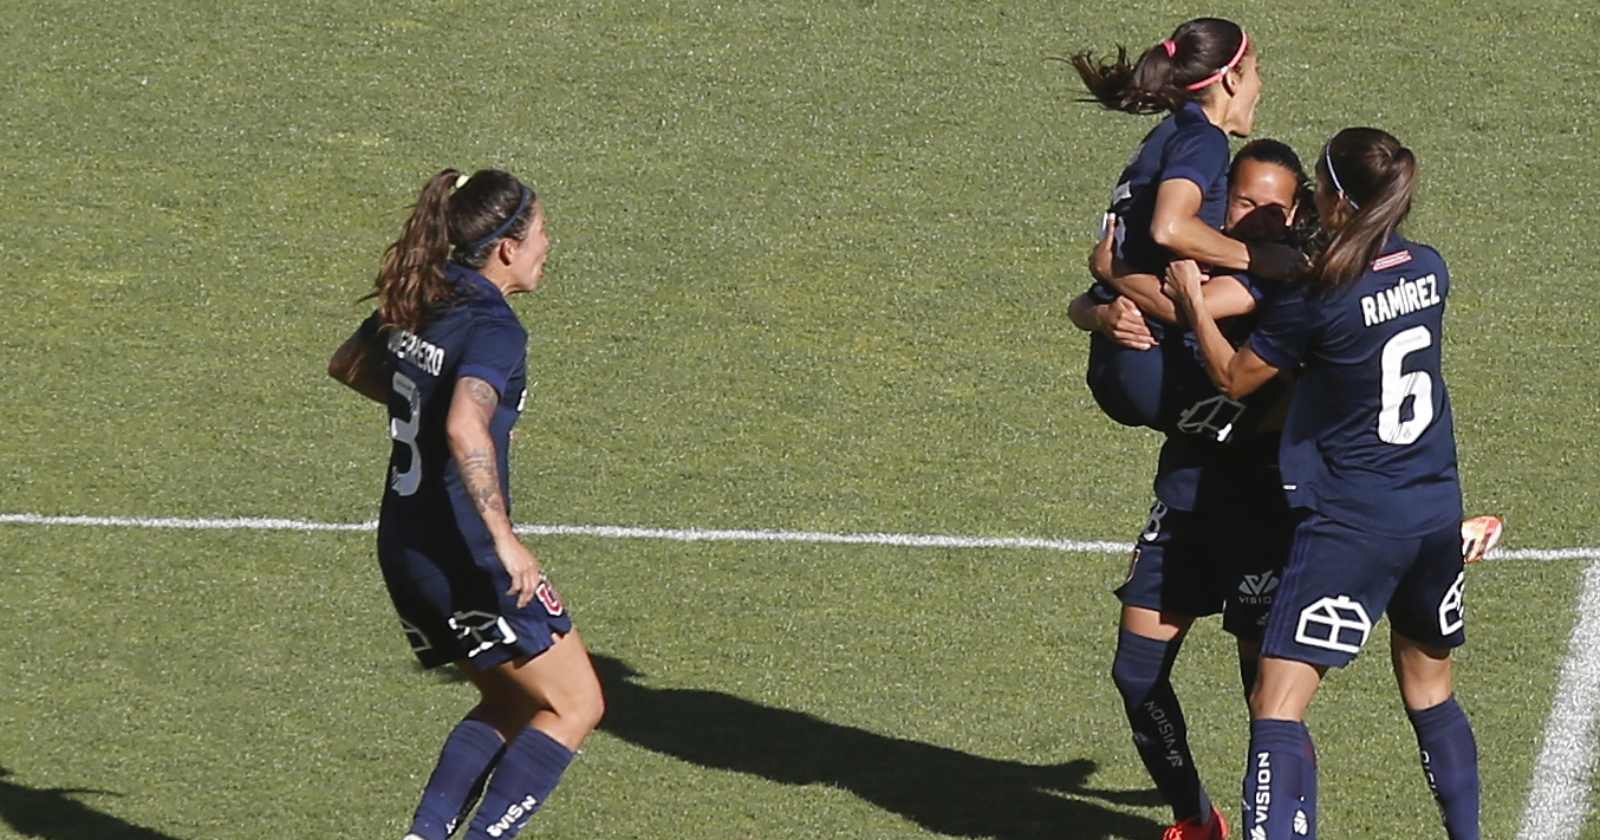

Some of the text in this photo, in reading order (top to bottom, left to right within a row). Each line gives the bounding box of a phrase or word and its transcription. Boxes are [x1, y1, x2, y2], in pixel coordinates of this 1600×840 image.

[1361, 273, 1440, 327] RAMÍREZ
[387, 329, 445, 376] UERRERO
[1378, 325, 1433, 445] 6
[390, 371, 422, 496] 3
[1238, 595, 1272, 605] VISIO
[1144, 701, 1176, 749] VISION
[496, 795, 537, 831] VISN
[1255, 752, 1271, 823] VISION
